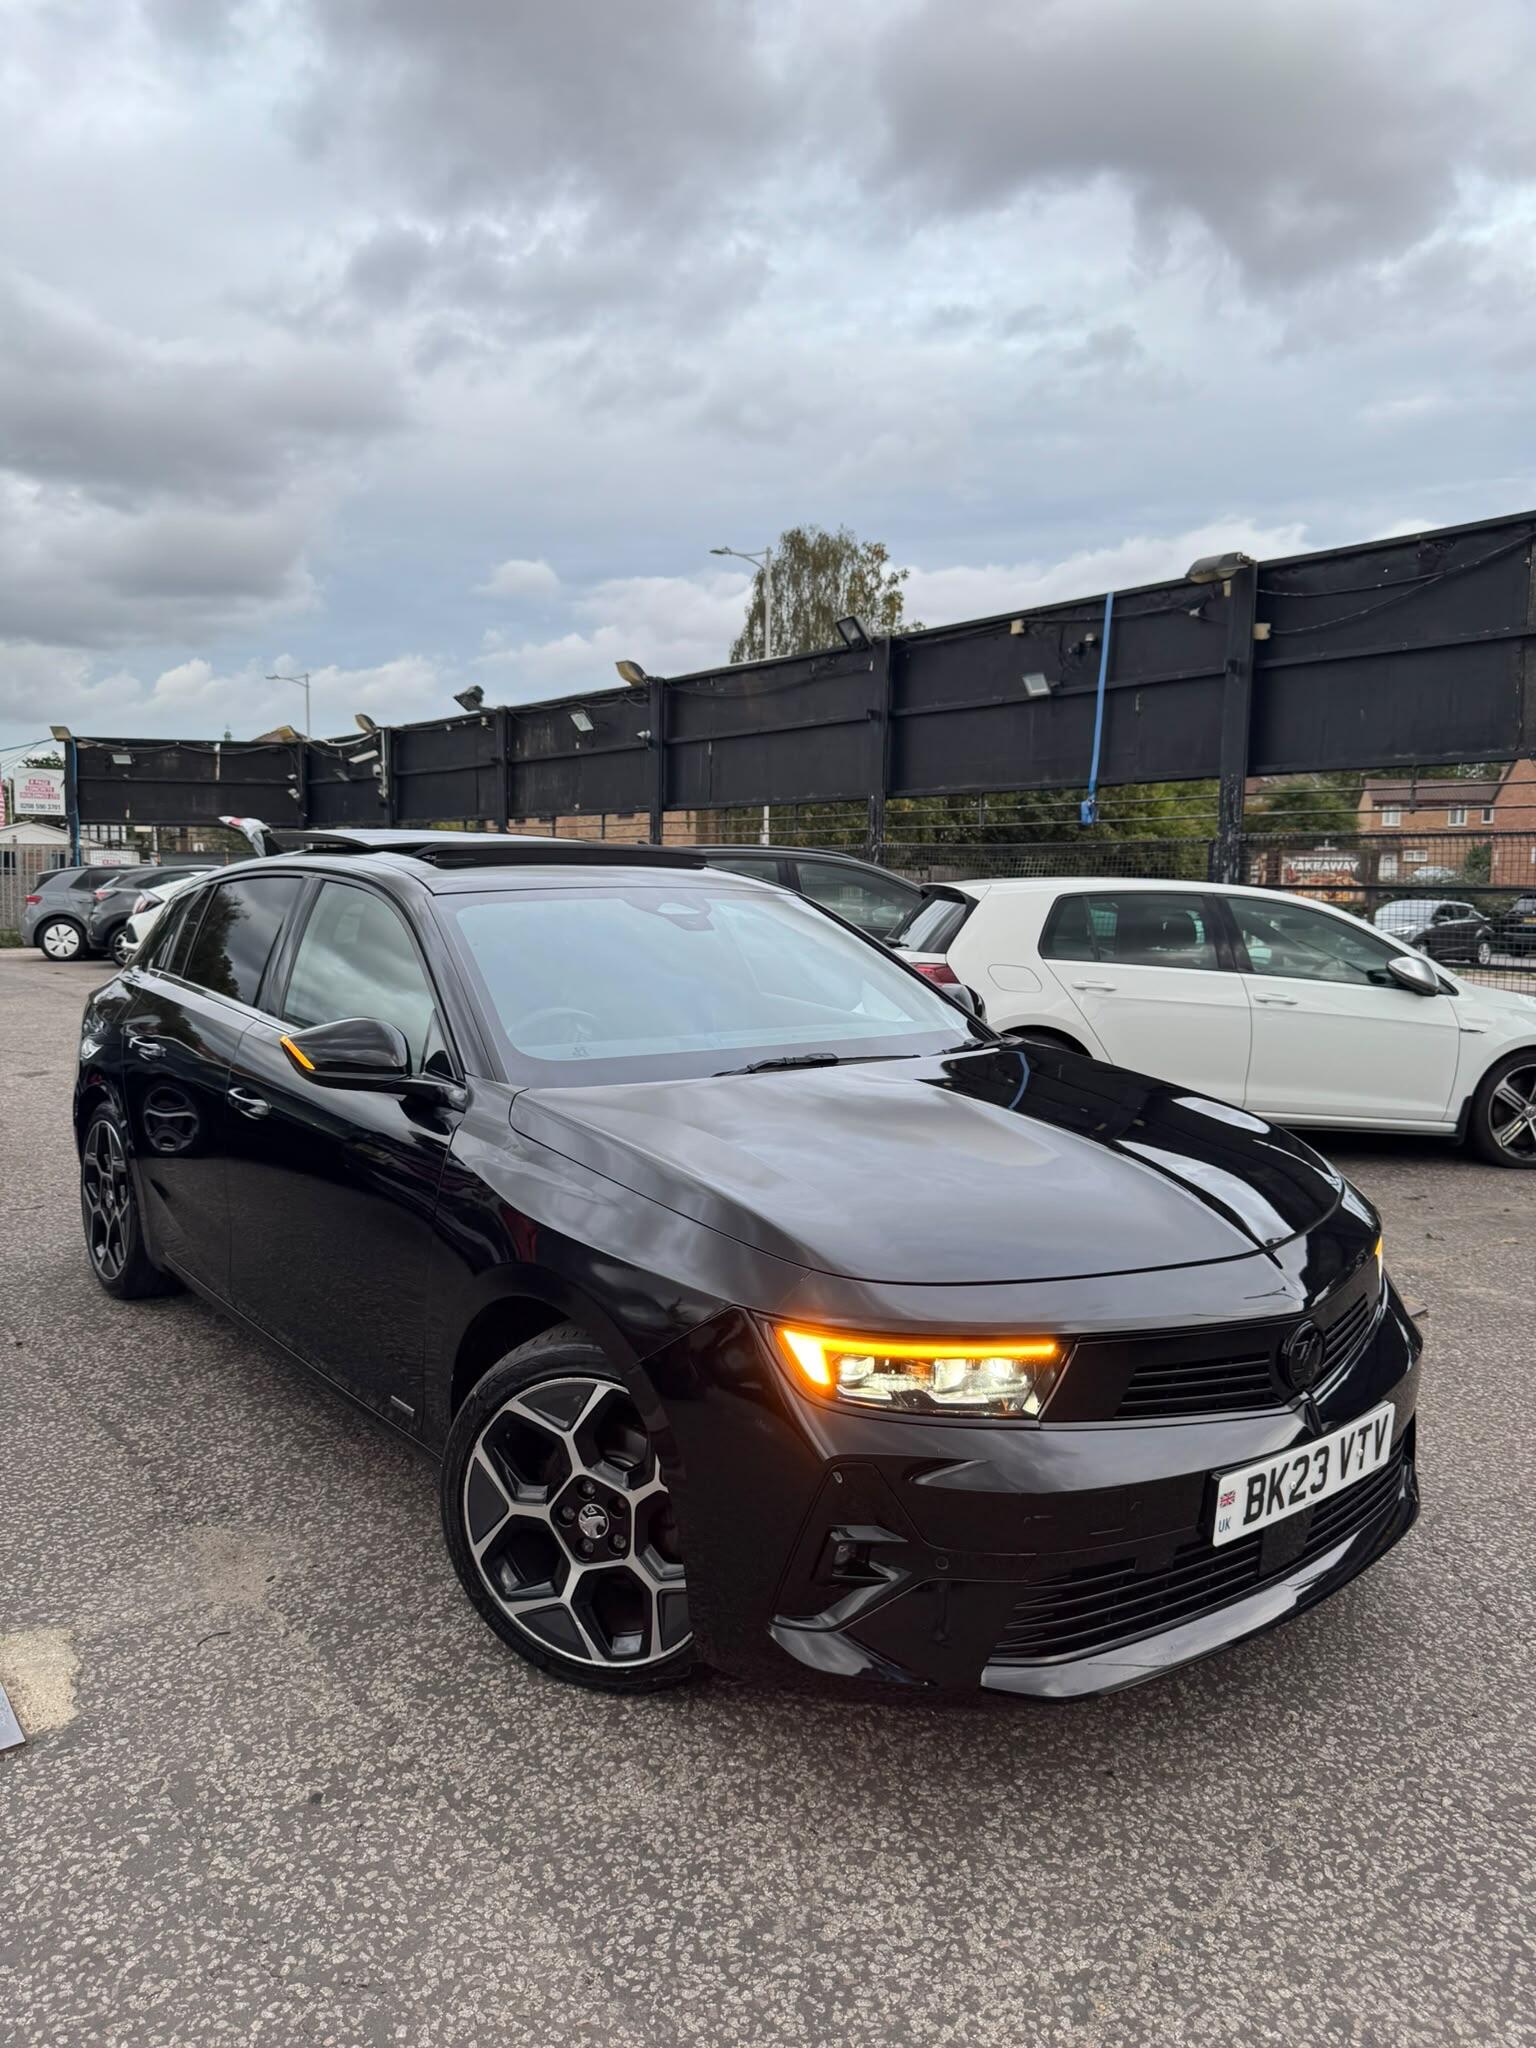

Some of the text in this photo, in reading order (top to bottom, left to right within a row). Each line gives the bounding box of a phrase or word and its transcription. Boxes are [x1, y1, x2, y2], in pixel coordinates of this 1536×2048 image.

[1290, 861, 1359, 872] TAKEAWAY
[1243, 1413, 1389, 1526] BK23 VTV
[1218, 1516, 1231, 1533] UK
